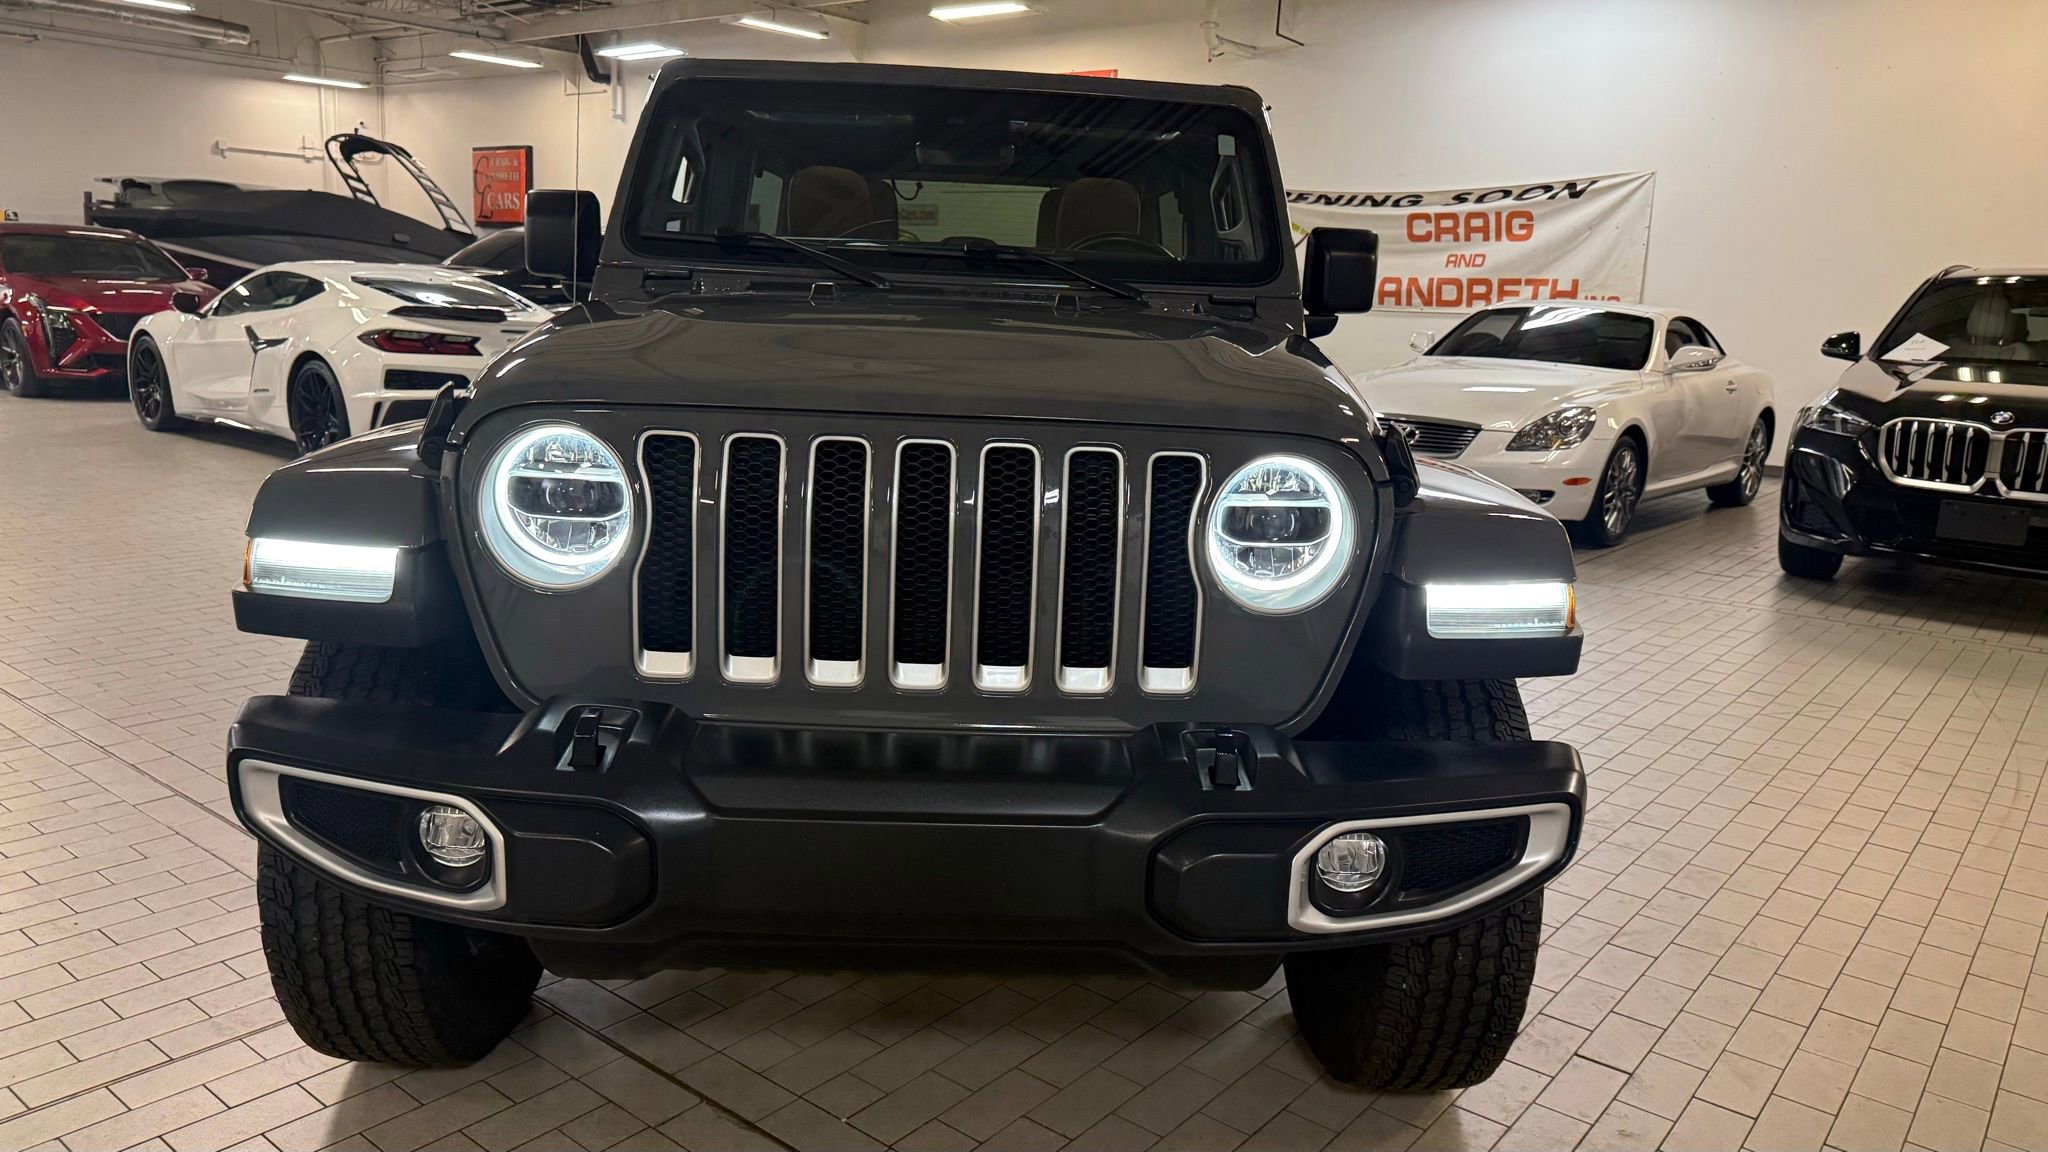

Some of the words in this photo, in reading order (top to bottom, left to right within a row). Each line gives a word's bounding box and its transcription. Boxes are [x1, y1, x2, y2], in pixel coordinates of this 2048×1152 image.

[487, 192, 520, 209] CARS
[1444, 180, 1600, 206] SOON
[1407, 211, 1534, 243] CRAIG
[1445, 254, 1486, 268] AND
[1377, 277, 1579, 307] ANDRETH
